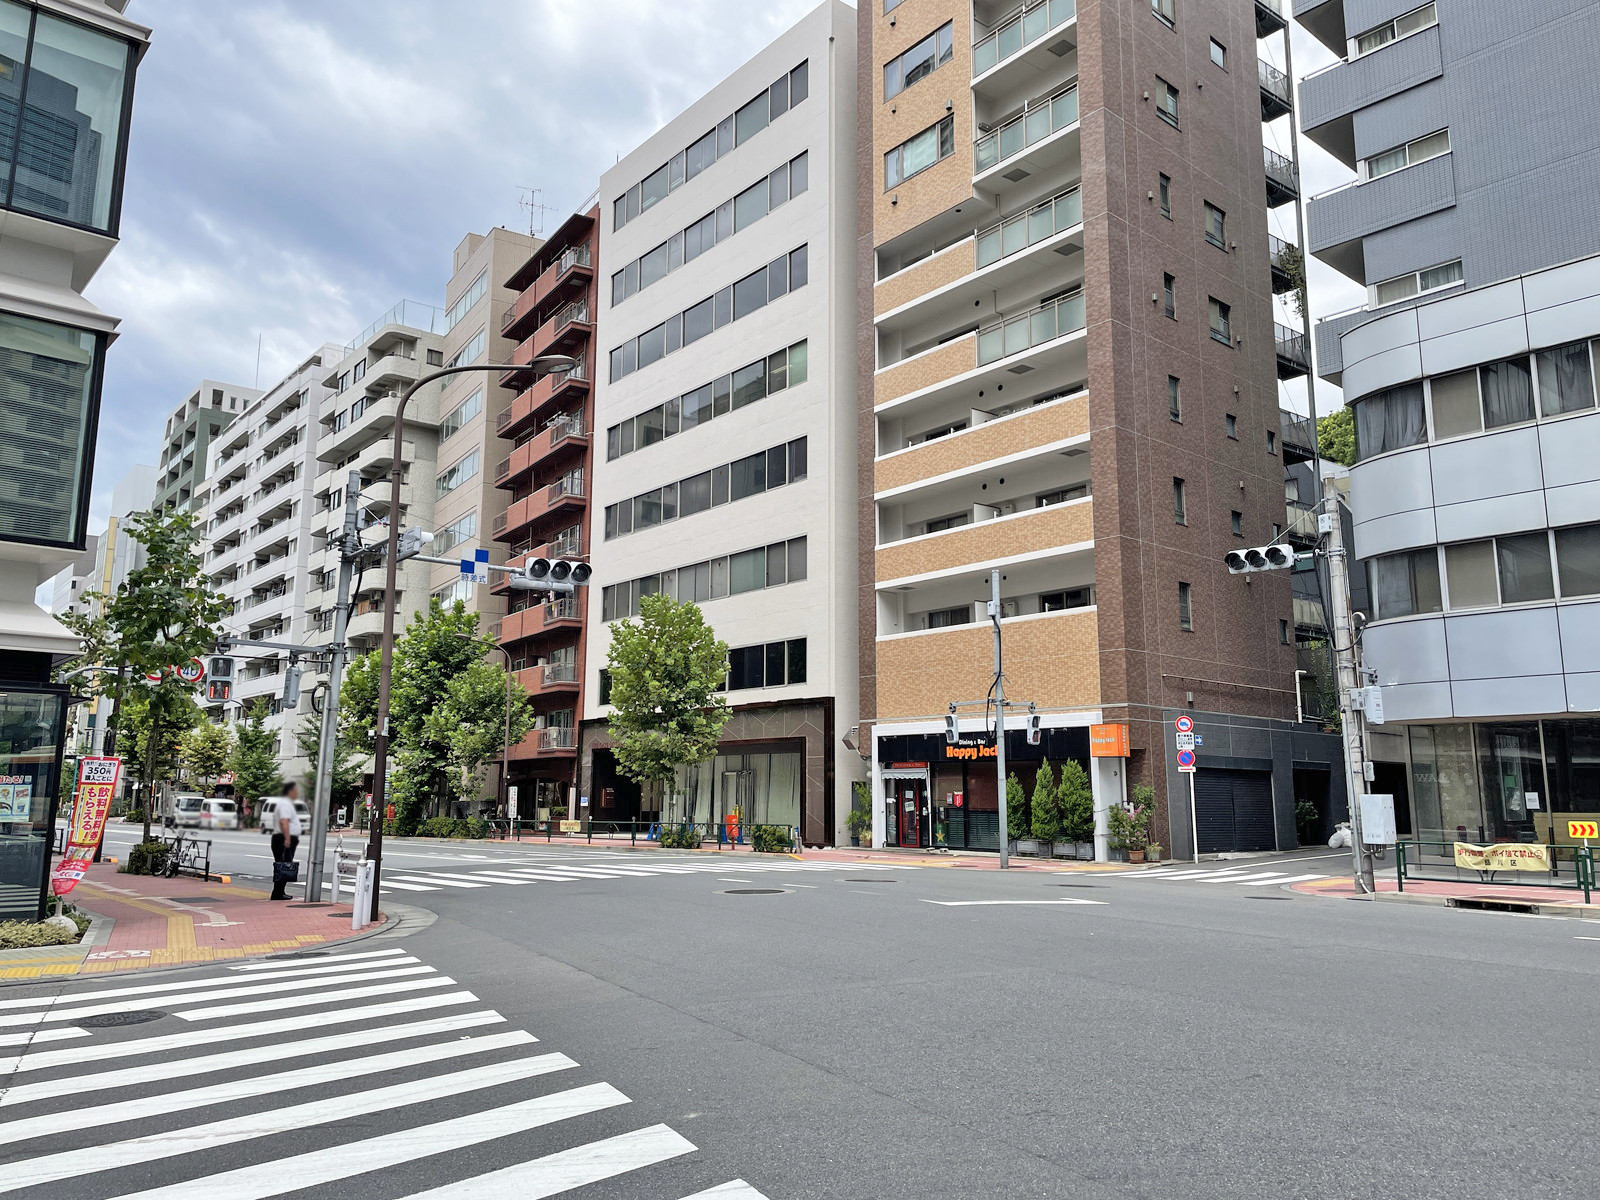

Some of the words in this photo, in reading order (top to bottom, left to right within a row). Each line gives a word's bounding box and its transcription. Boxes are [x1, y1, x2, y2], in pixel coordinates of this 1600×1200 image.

[461, 573, 486, 583] 時差式
[946, 746, 977, 759] Happy
[87, 767, 111, 775] 350円
[82, 787, 97, 841] もらえる！
[88, 787, 109, 841] 飲料無料券
